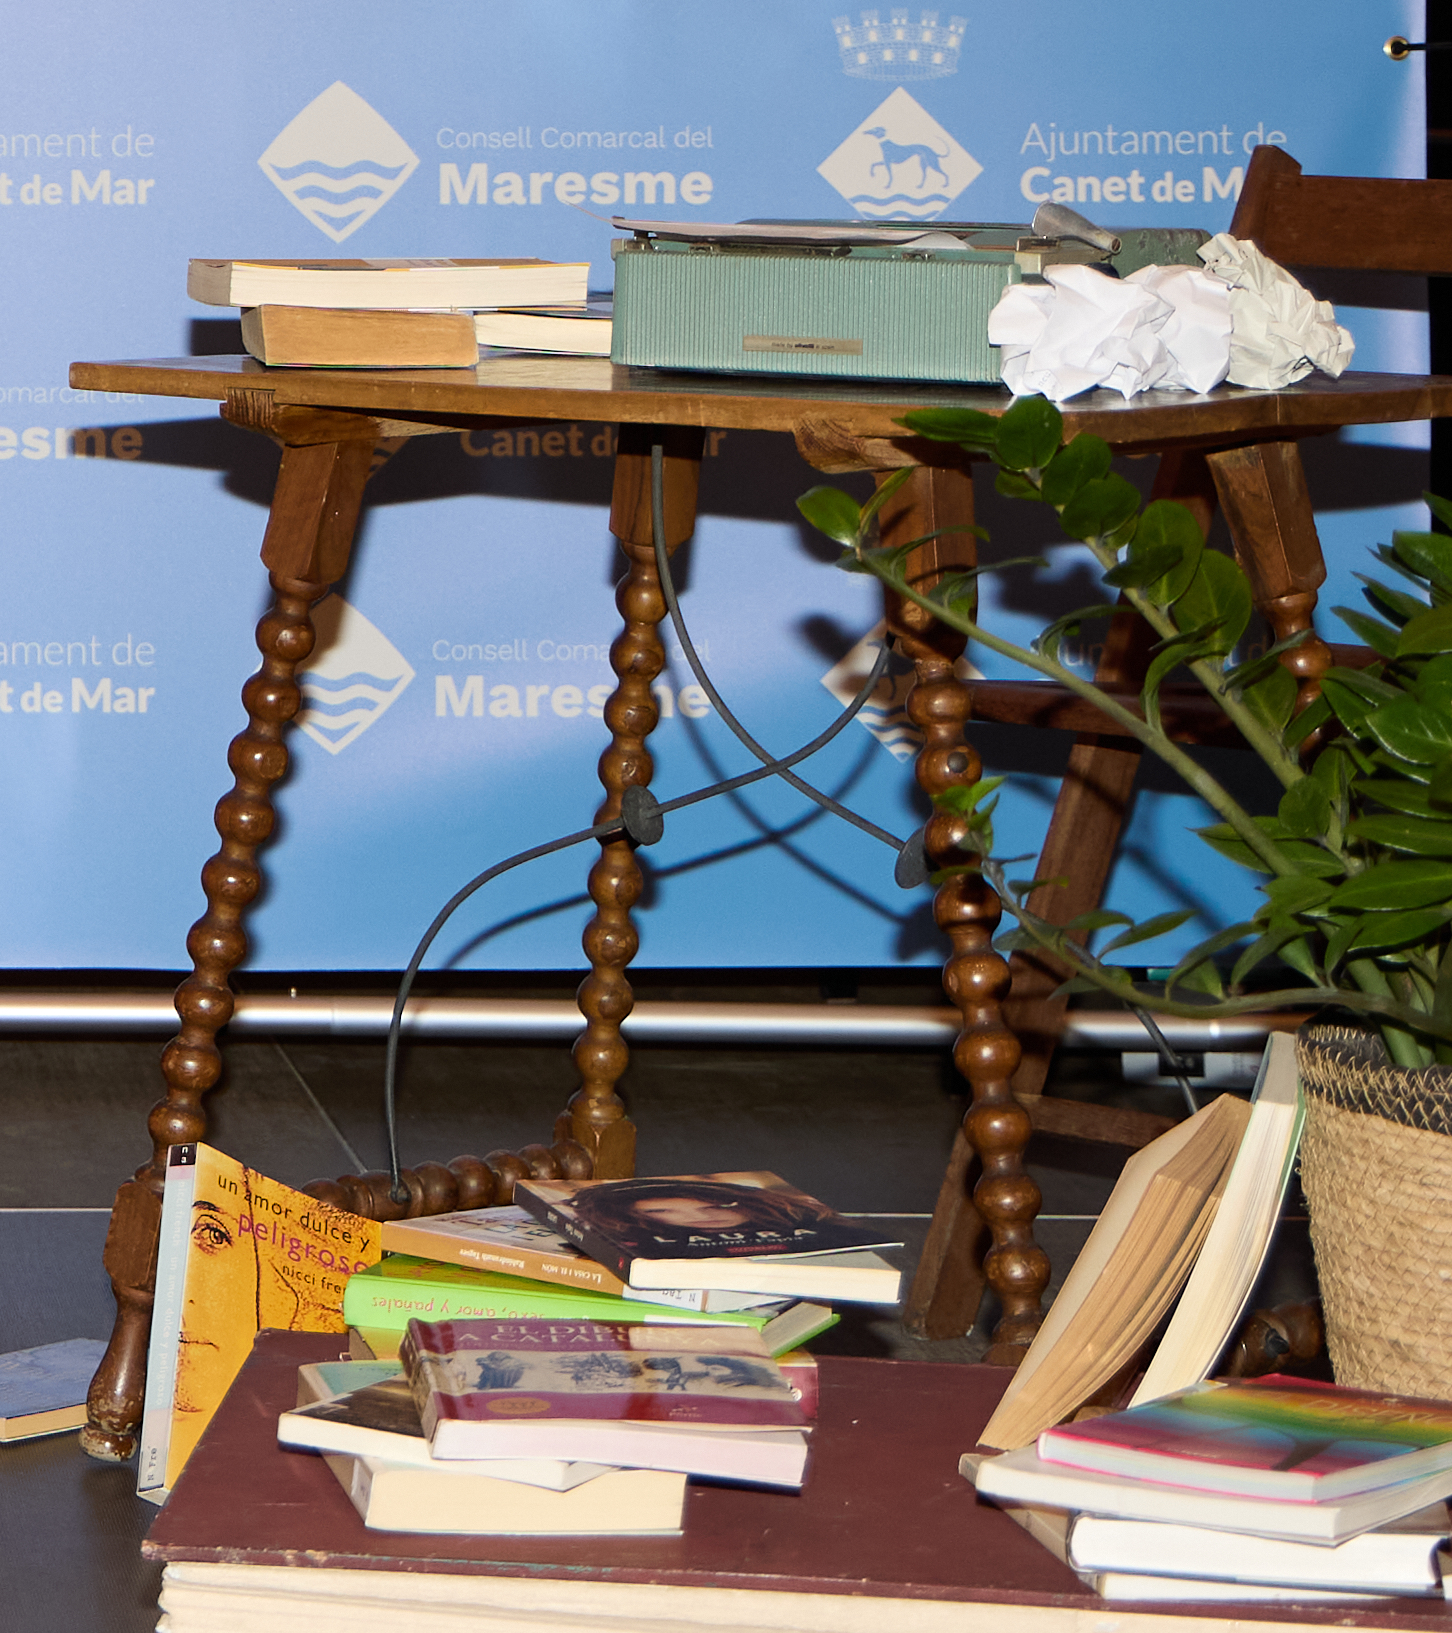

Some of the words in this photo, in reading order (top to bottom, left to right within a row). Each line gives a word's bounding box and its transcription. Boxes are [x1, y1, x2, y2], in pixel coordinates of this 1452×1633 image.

[112, 126, 154, 156] de
[438, 128, 530, 148] Consell
[542, 128, 664, 148] Comarcal
[674, 128, 712, 148] del
[20, 174, 63, 205] de
[71, 169, 155, 205] Mar
[440, 163, 713, 205] Maresme
[217, 1174, 238, 1195] un
[244, 1190, 292, 1219] amor
[300, 1212, 352, 1244] dulce
[360, 1236, 371, 1253] y
[237, 1214, 369, 1276] peligroso
[654, 1227, 818, 1243] LAURA
[282, 1264, 315, 1285] nicci
[372, 1295, 435, 1313] pañales
[441, 1298, 450, 1313] y
[455, 1305, 497, 1319] amor
